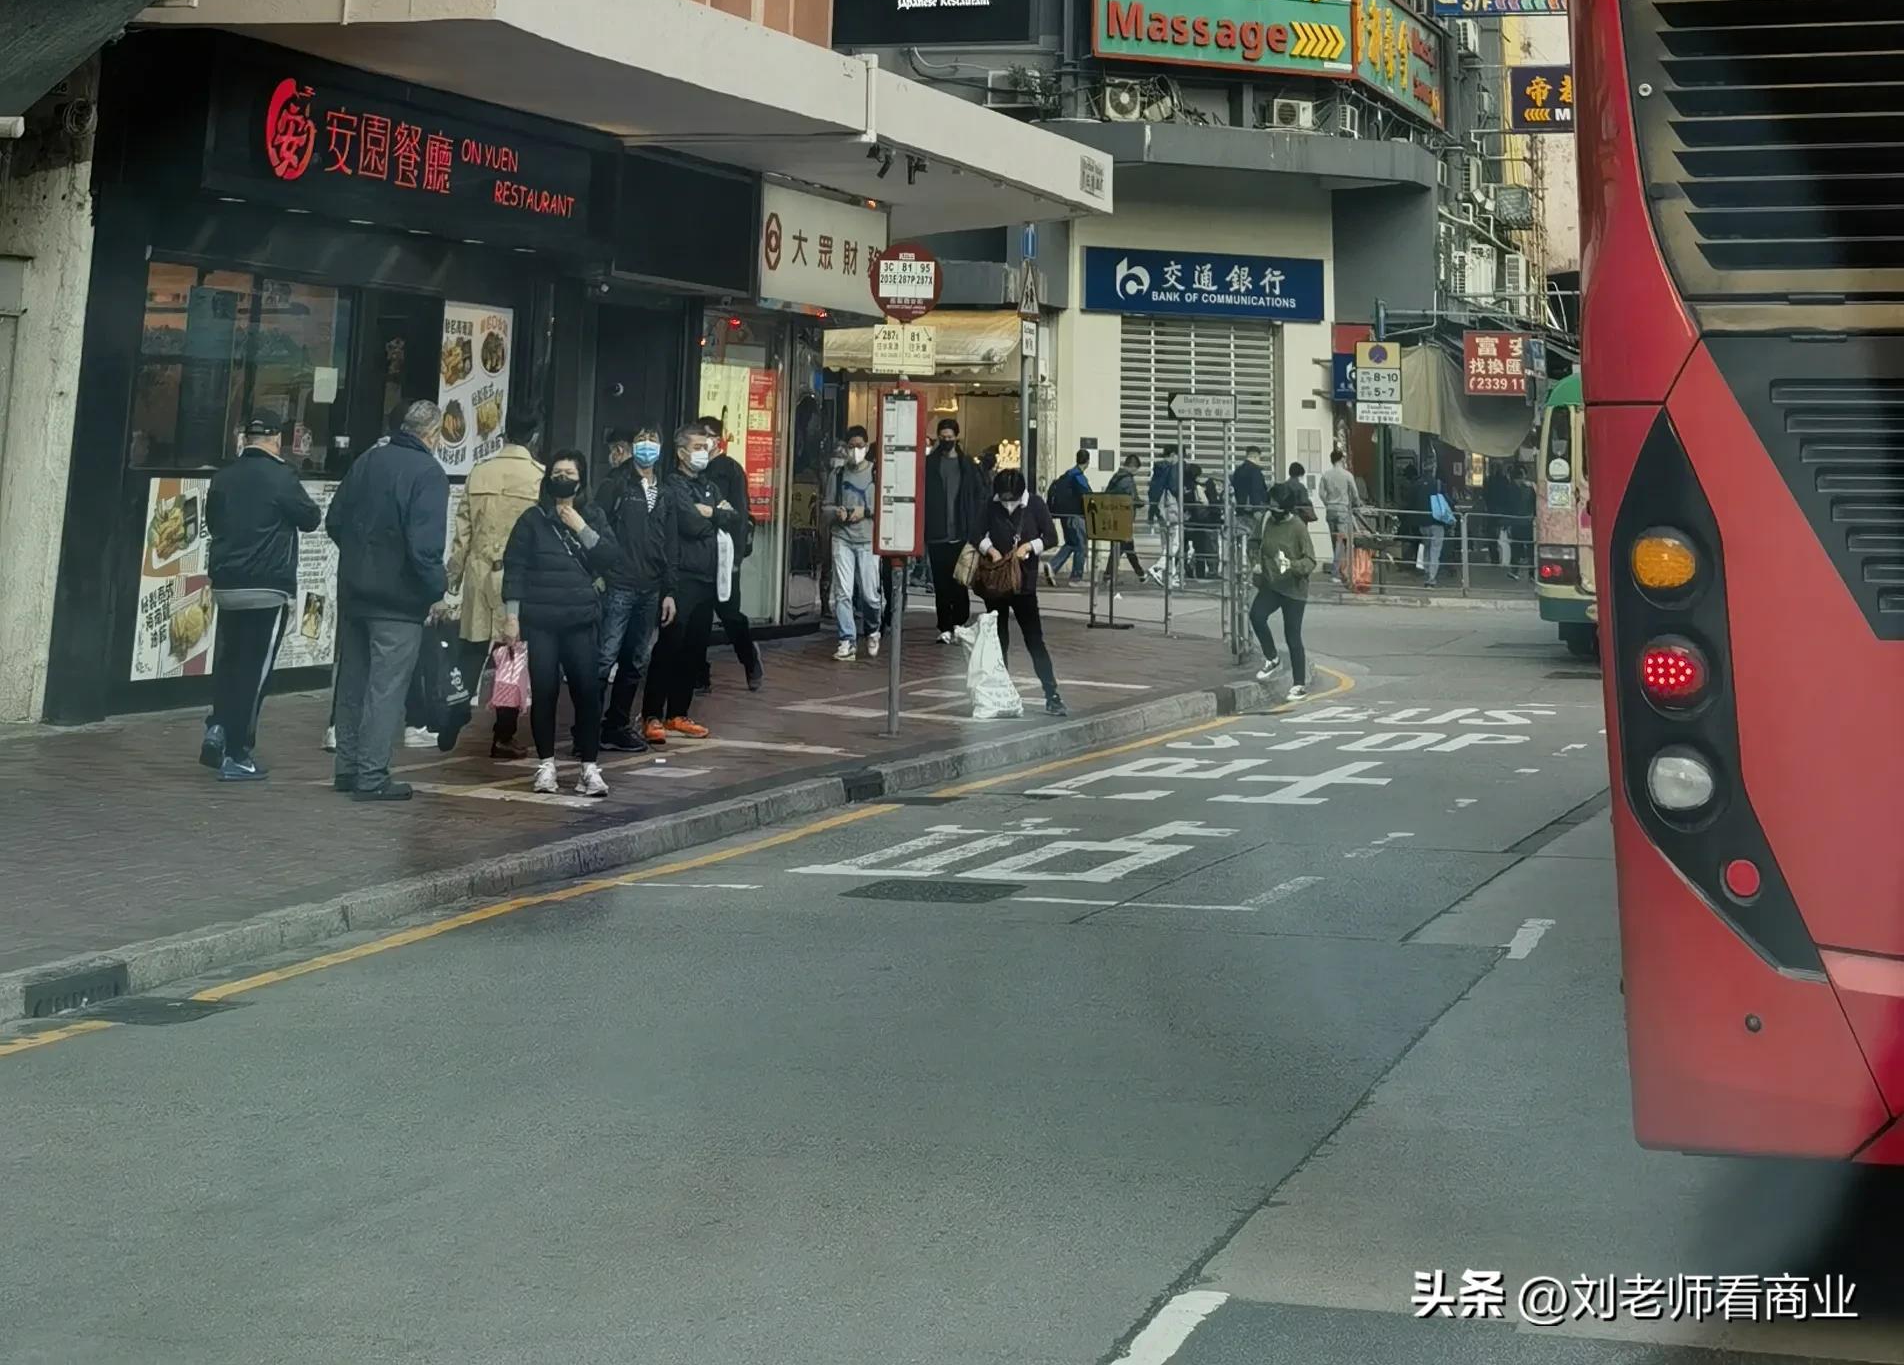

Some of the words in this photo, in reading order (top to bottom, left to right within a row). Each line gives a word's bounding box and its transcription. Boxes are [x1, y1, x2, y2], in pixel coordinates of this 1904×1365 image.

[1107, 0, 1289, 61] Massage
[324, 107, 454, 194] 安園餐廳
[461, 138, 482, 165] ON
[484, 144, 519, 173] YUEN
[493, 180, 575, 219] RESTAURANT
[1162, 260, 1286, 295] 交通銀行
[1151, 291, 1181, 303] BANK
[1184, 293, 1198, 303] OF
[1201, 293, 1297, 309] COMMUNICATIONS
[1477, 378, 1507, 390] 2339
[1280, 705, 1558, 726] BUS
[1167, 731, 1532, 753] STOP
[1022, 758, 1393, 806] 巴士
